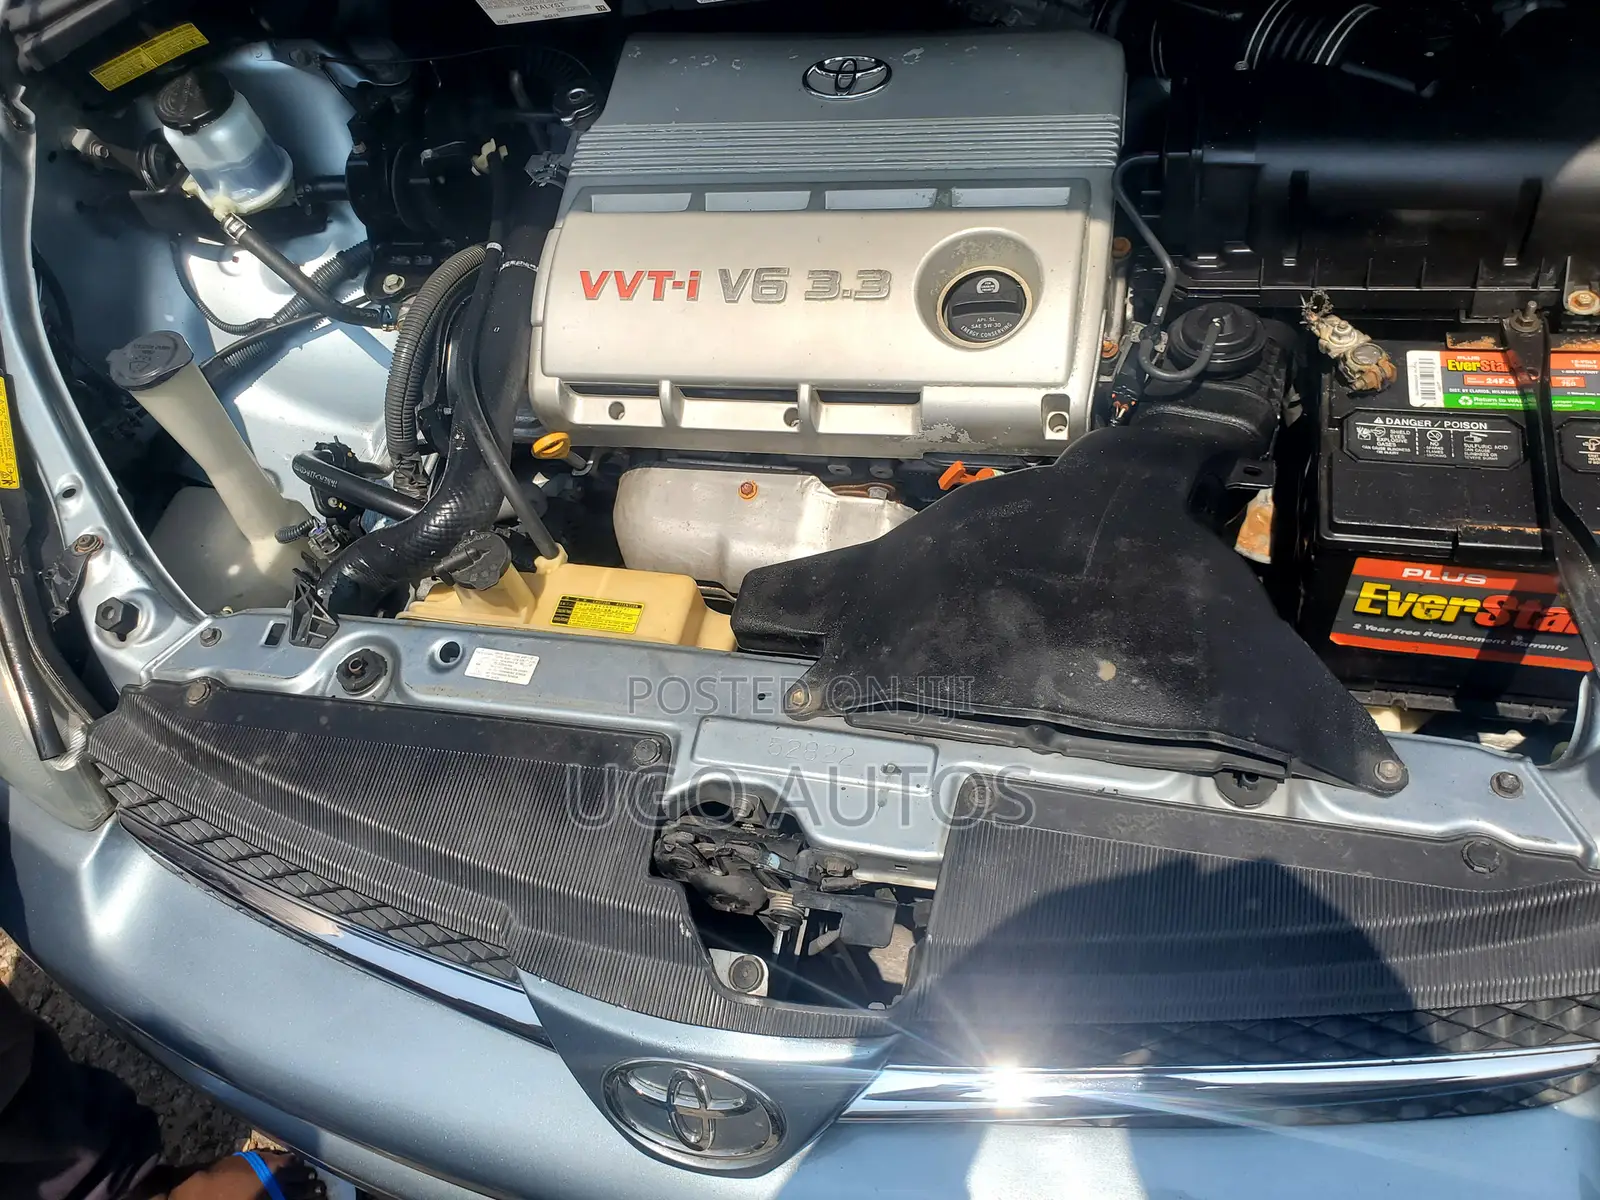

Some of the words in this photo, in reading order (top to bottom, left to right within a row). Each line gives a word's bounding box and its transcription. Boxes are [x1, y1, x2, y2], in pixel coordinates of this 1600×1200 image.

[523, 2, 565, 12] CATALYST
[579, 270, 702, 301] VVT-i
[718, 266, 791, 304] V6
[804, 269, 893, 301] 3.3
[960, 325, 980, 337] ENERGY
[980, 322, 1013, 338] CONSERVING
[1385, 417, 1432, 428] DANGER
[1433, 420, 1441, 428] /
[1443, 419, 1488, 430] POISON
[1401, 567, 1487, 585] PLUS
[1364, 624, 1392, 634] Year
[1392, 628, 1421, 638] Free
[1422, 629, 1507, 646] Replacement
[1510, 639, 1569, 653] Warranty
